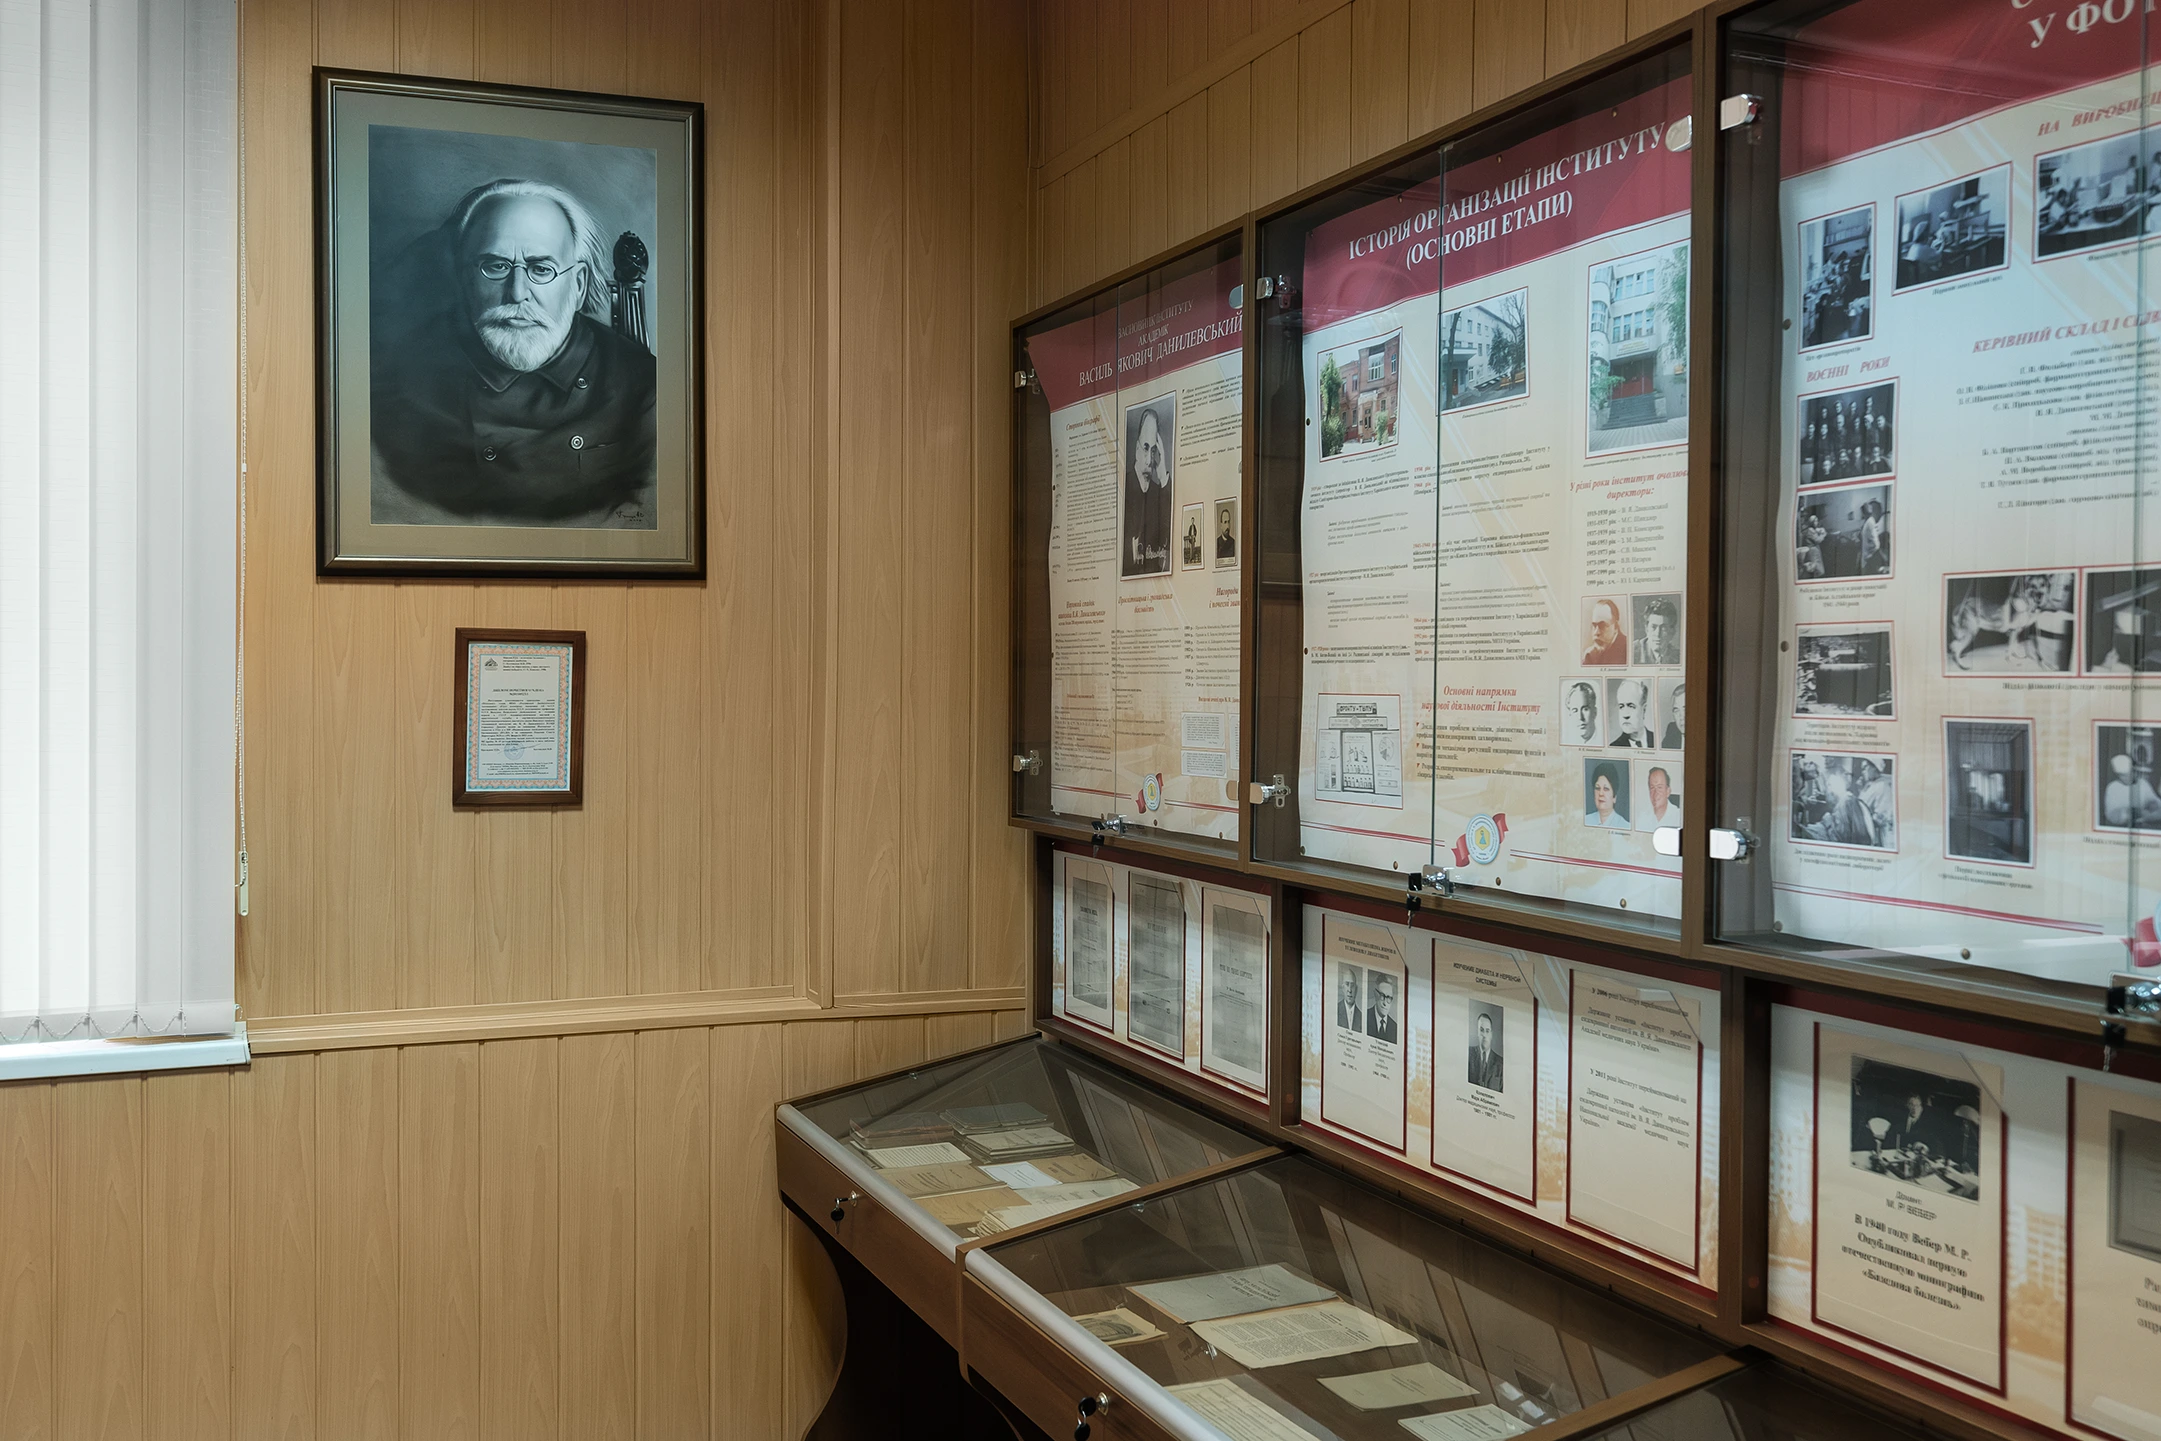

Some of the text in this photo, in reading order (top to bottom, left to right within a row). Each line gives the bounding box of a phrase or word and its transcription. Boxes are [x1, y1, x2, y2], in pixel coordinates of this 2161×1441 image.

[2028, 0, 2157, 48] У ФО
[2038, 120, 2060, 136] НА
[1349, 122, 1666, 260] ІСТОРІЯ ОРГАНІЗАЦІЇ ІНСТИТУТУ
[1406, 190, 1573, 270] (ОСНОВНІ ЕТАПИ)
[1079, 311, 1242, 387] ВАСИЛЬ ЯКОВИЧ ДАНИЛЕВСЬКИЙ
[1972, 326, 2052, 353] КЕРІВНИЙ
[2054, 319, 2108, 340] СКЛАД
[1806, 356, 1890, 383] ВОЄННІ РОКИ
[1570, 482, 1574, 491] У
[1592, 480, 1610, 490] роки
[1611, 476, 1654, 486] інститут
[1607, 488, 1655, 500] директори:
[1421, 700, 1541, 715] науової діяльності Інституту
[1443, 685, 1517, 698] Основні напрямки
[1595, 1070, 1606, 1079] 2011
[1854, 1214, 1862, 1224] В
[1888, 1227, 1909, 1243] году
[1944, 1242, 1959, 1257] М.
[1961, 1249, 1972, 1262] Р.
[1857, 1232, 1967, 1277] Опубликовал первую
[1842, 1245, 1985, 1302] отечественную монографию
